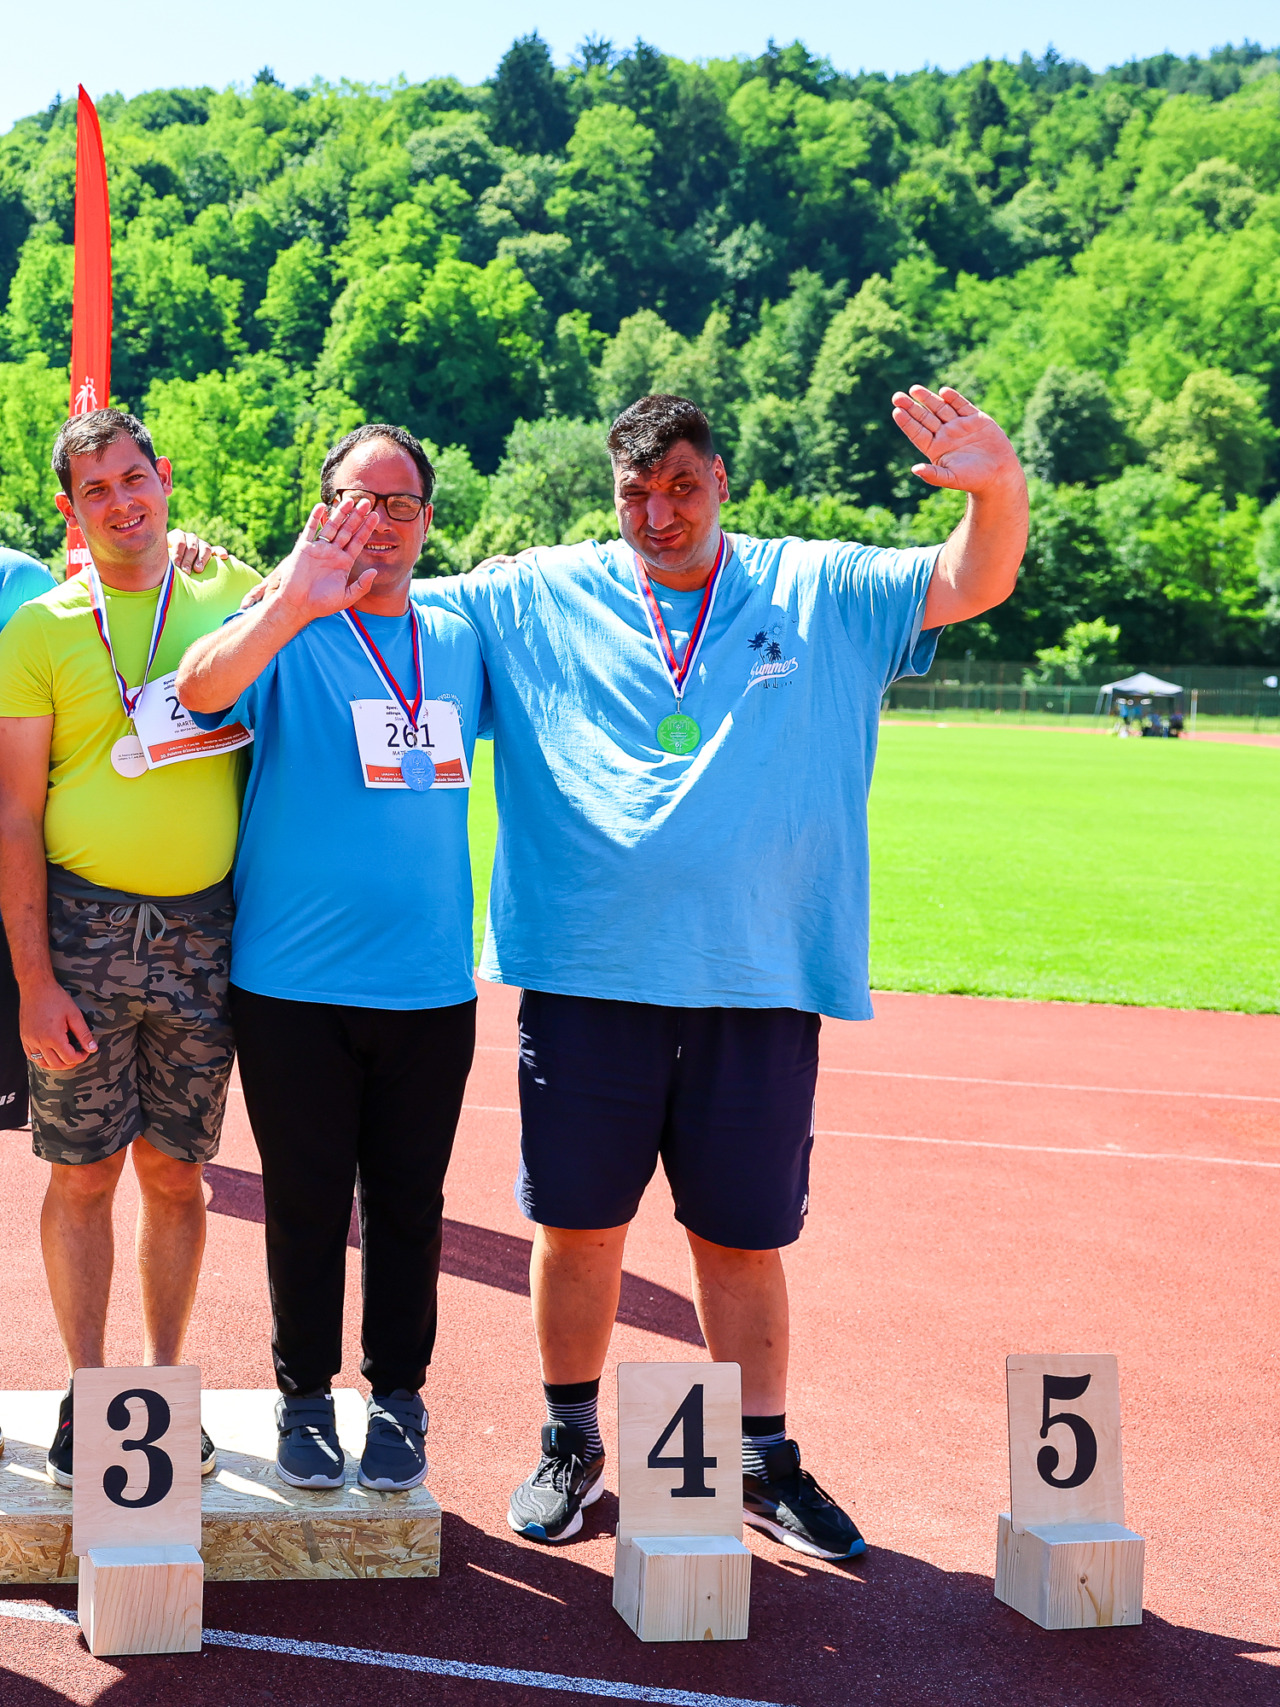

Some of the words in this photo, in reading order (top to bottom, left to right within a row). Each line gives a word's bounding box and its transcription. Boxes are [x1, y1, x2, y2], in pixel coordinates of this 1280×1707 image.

[386, 723, 435, 748] 261
[103, 1389, 173, 1508] 3
[648, 1384, 717, 1498] 4
[1037, 1375, 1098, 1489] 5
